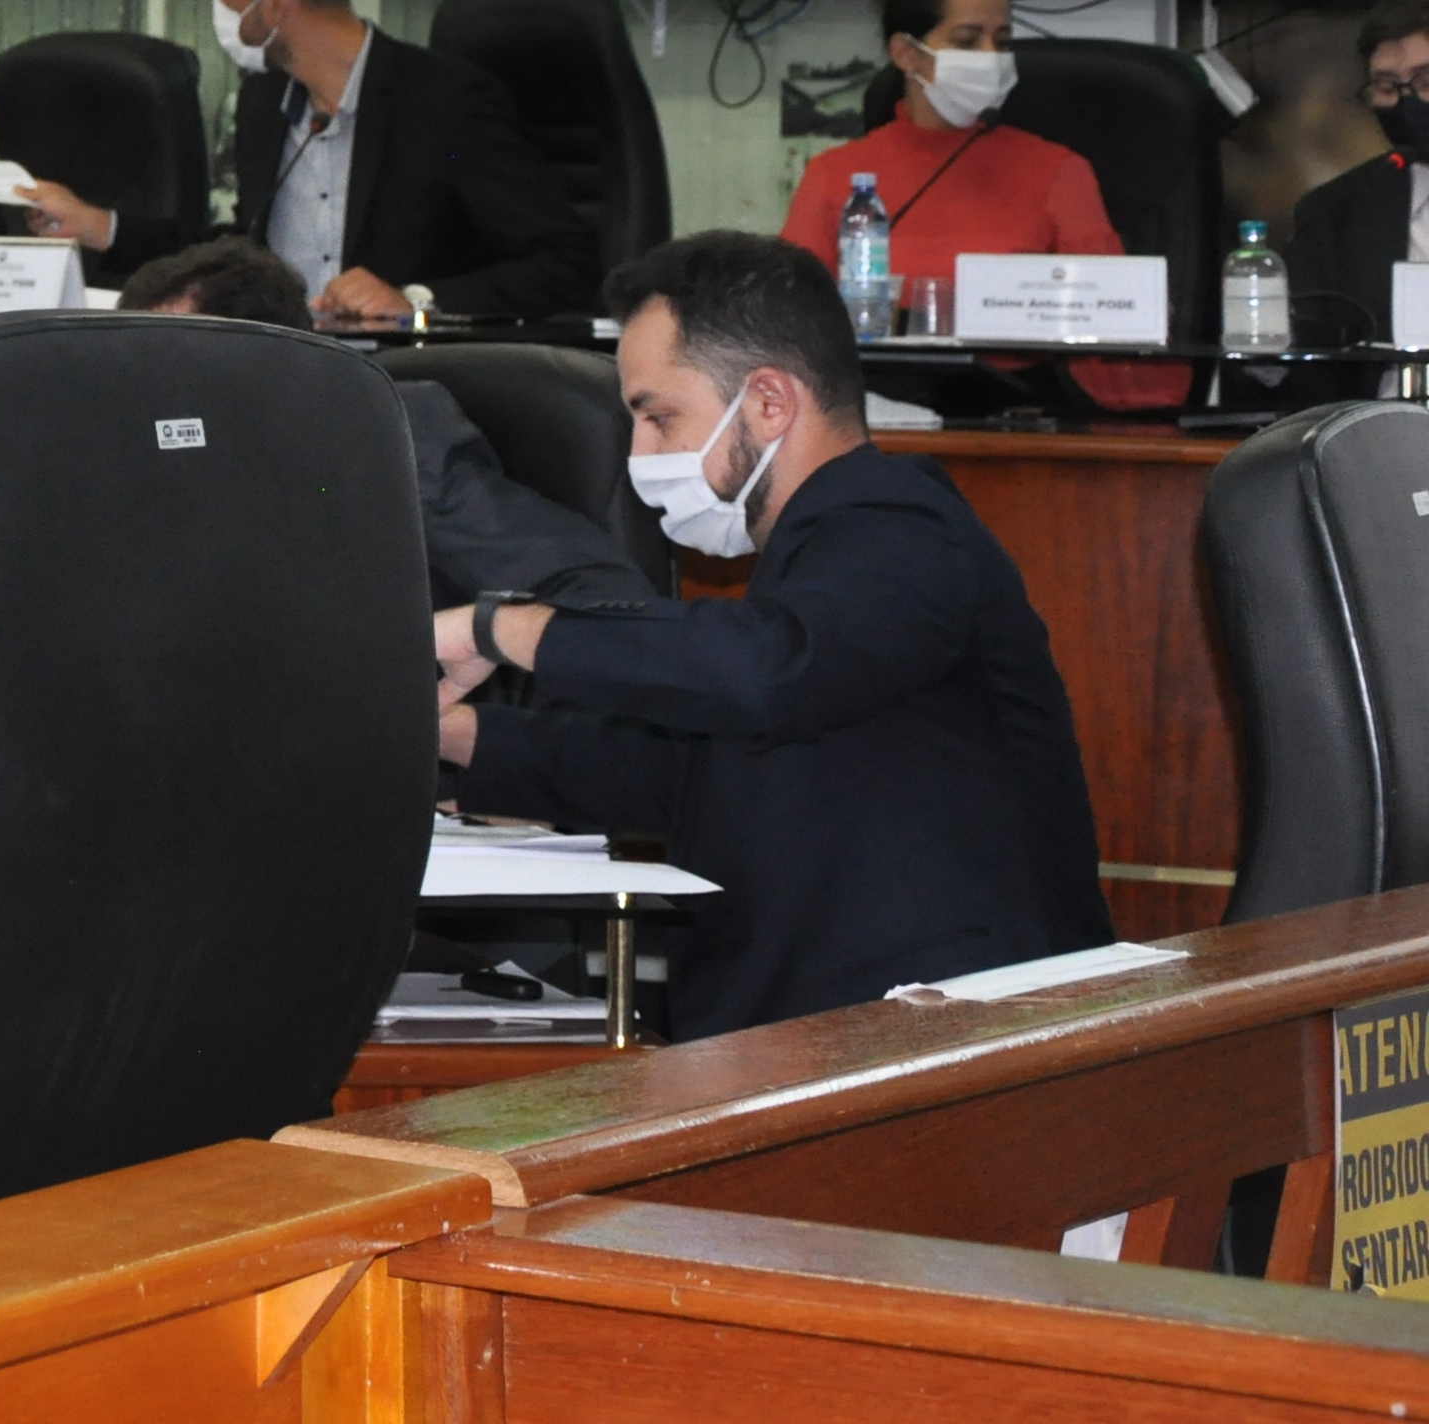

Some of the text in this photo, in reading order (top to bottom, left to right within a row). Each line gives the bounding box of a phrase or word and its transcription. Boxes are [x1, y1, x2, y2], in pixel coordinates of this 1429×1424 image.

[1030, 298, 1084, 308] Antues
[1097, 299, 1135, 309] PODE
[1340, 1132, 1429, 1212] ROIBIDO
